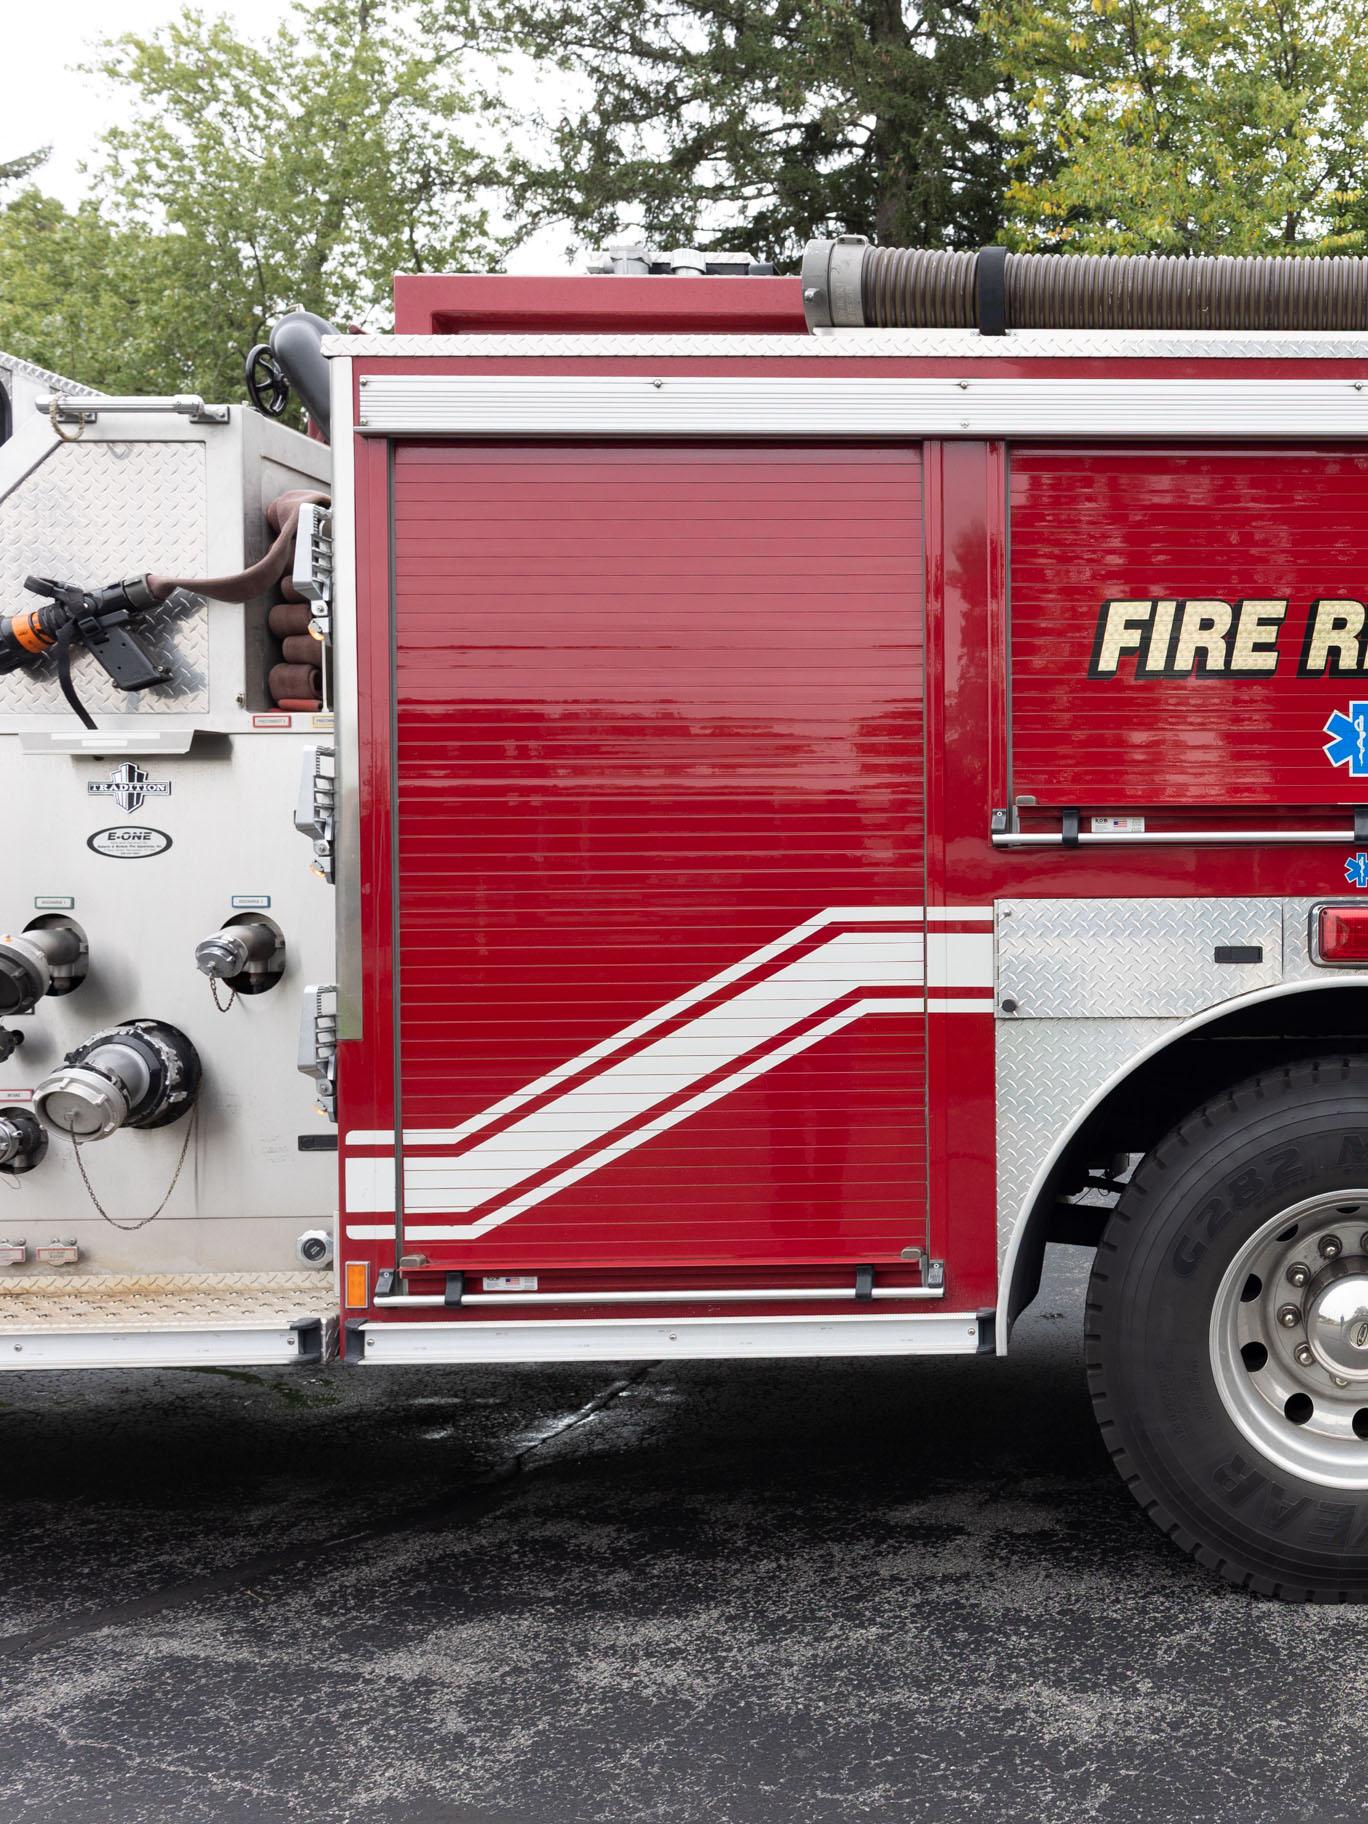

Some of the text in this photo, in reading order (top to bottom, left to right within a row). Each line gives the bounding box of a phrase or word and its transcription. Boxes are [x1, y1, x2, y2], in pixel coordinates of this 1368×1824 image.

[1089, 598, 1288, 678] FIRE
[91, 784, 166, 792] TRADITION
[107, 831, 152, 840] E-ONE
[1173, 1144, 1303, 1278] G282
